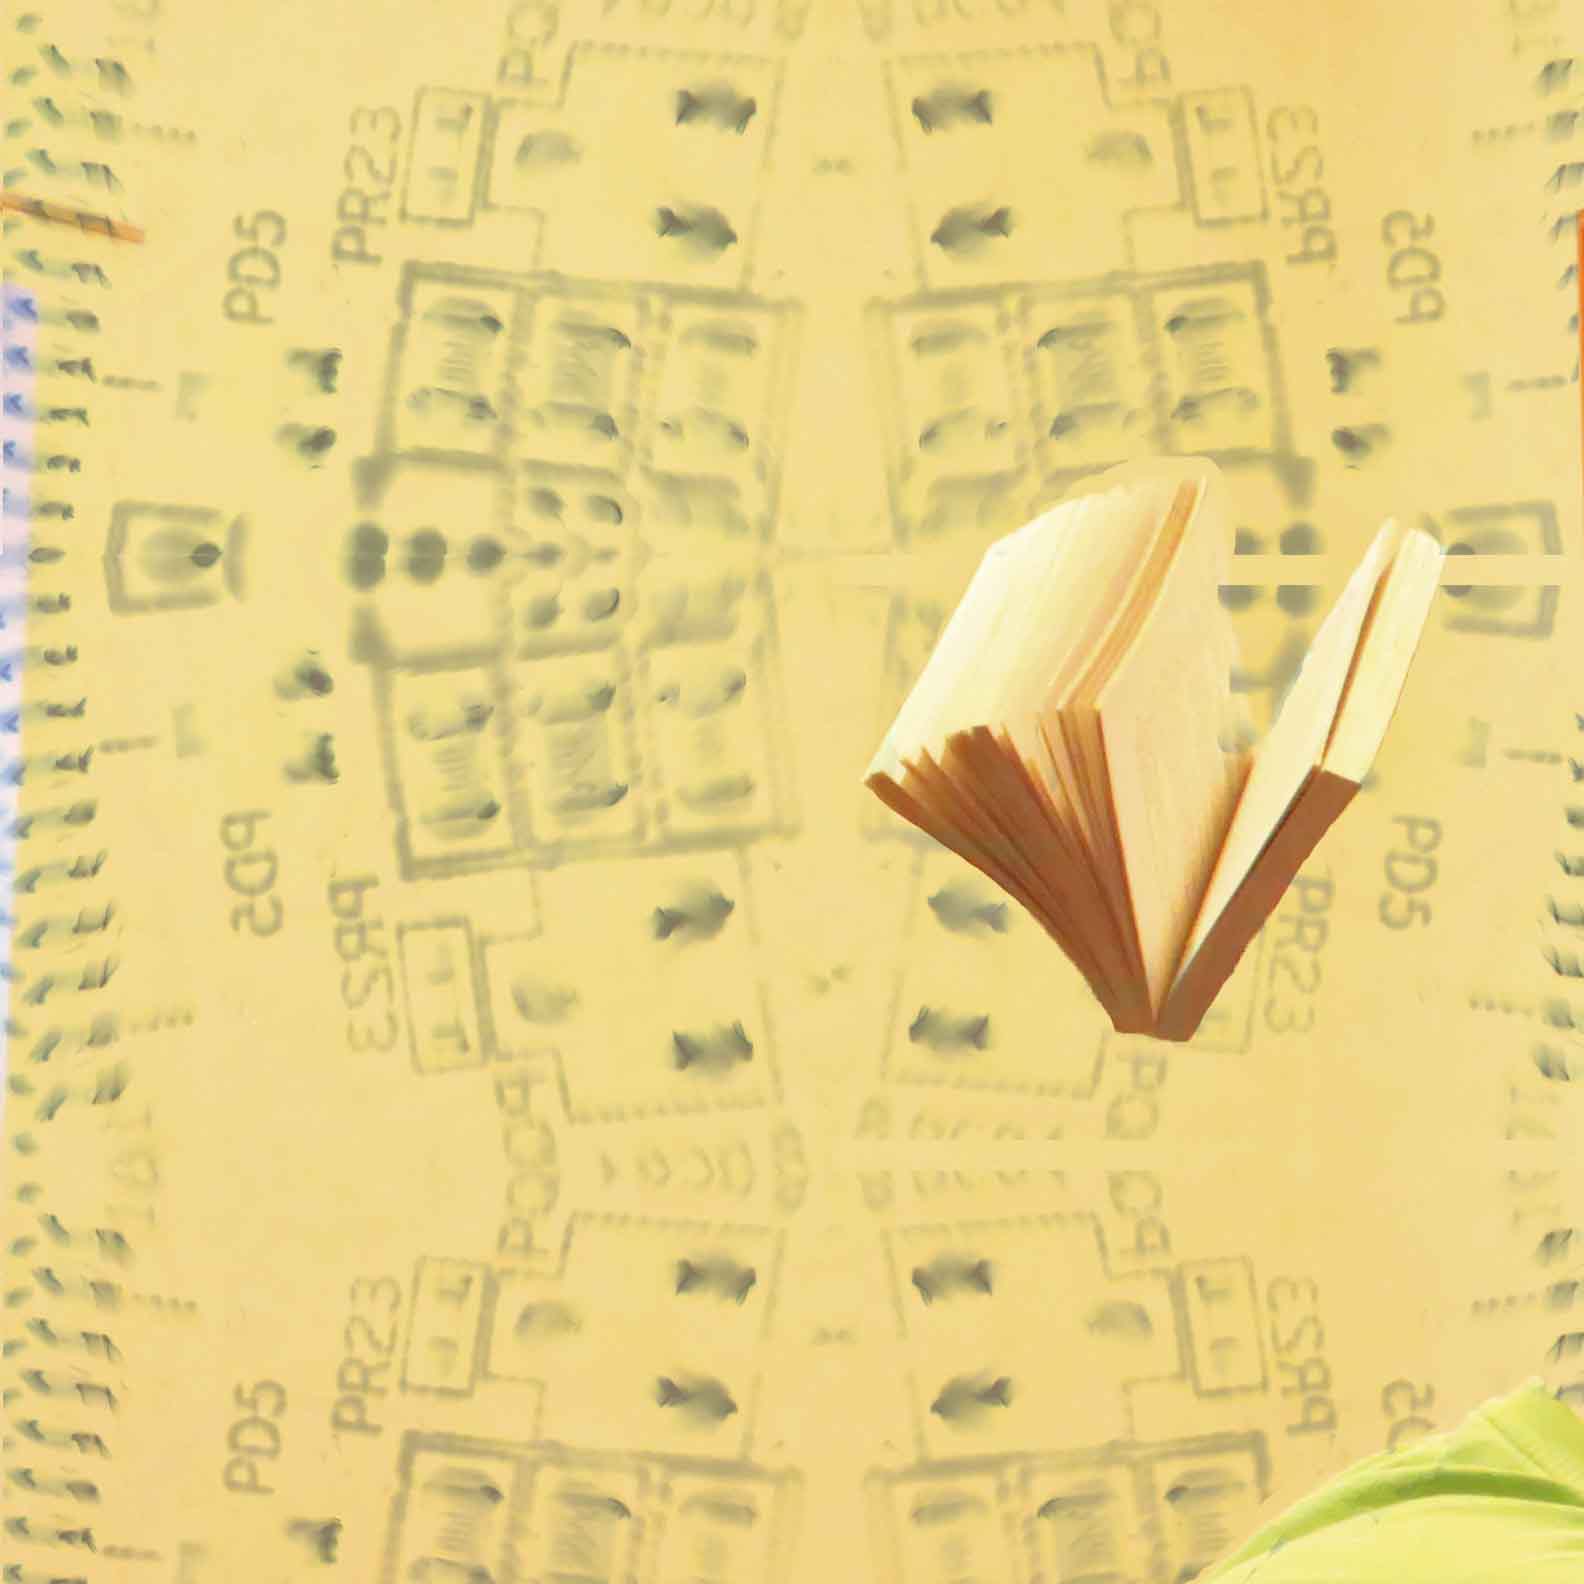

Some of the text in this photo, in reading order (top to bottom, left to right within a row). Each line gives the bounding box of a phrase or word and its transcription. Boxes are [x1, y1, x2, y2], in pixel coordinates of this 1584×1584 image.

[330, 104, 403, 268] PR23
[221, 207, 289, 326] PD5
[330, 1275, 403, 1438] PR23
[221, 1377, 289, 1498] PD5
